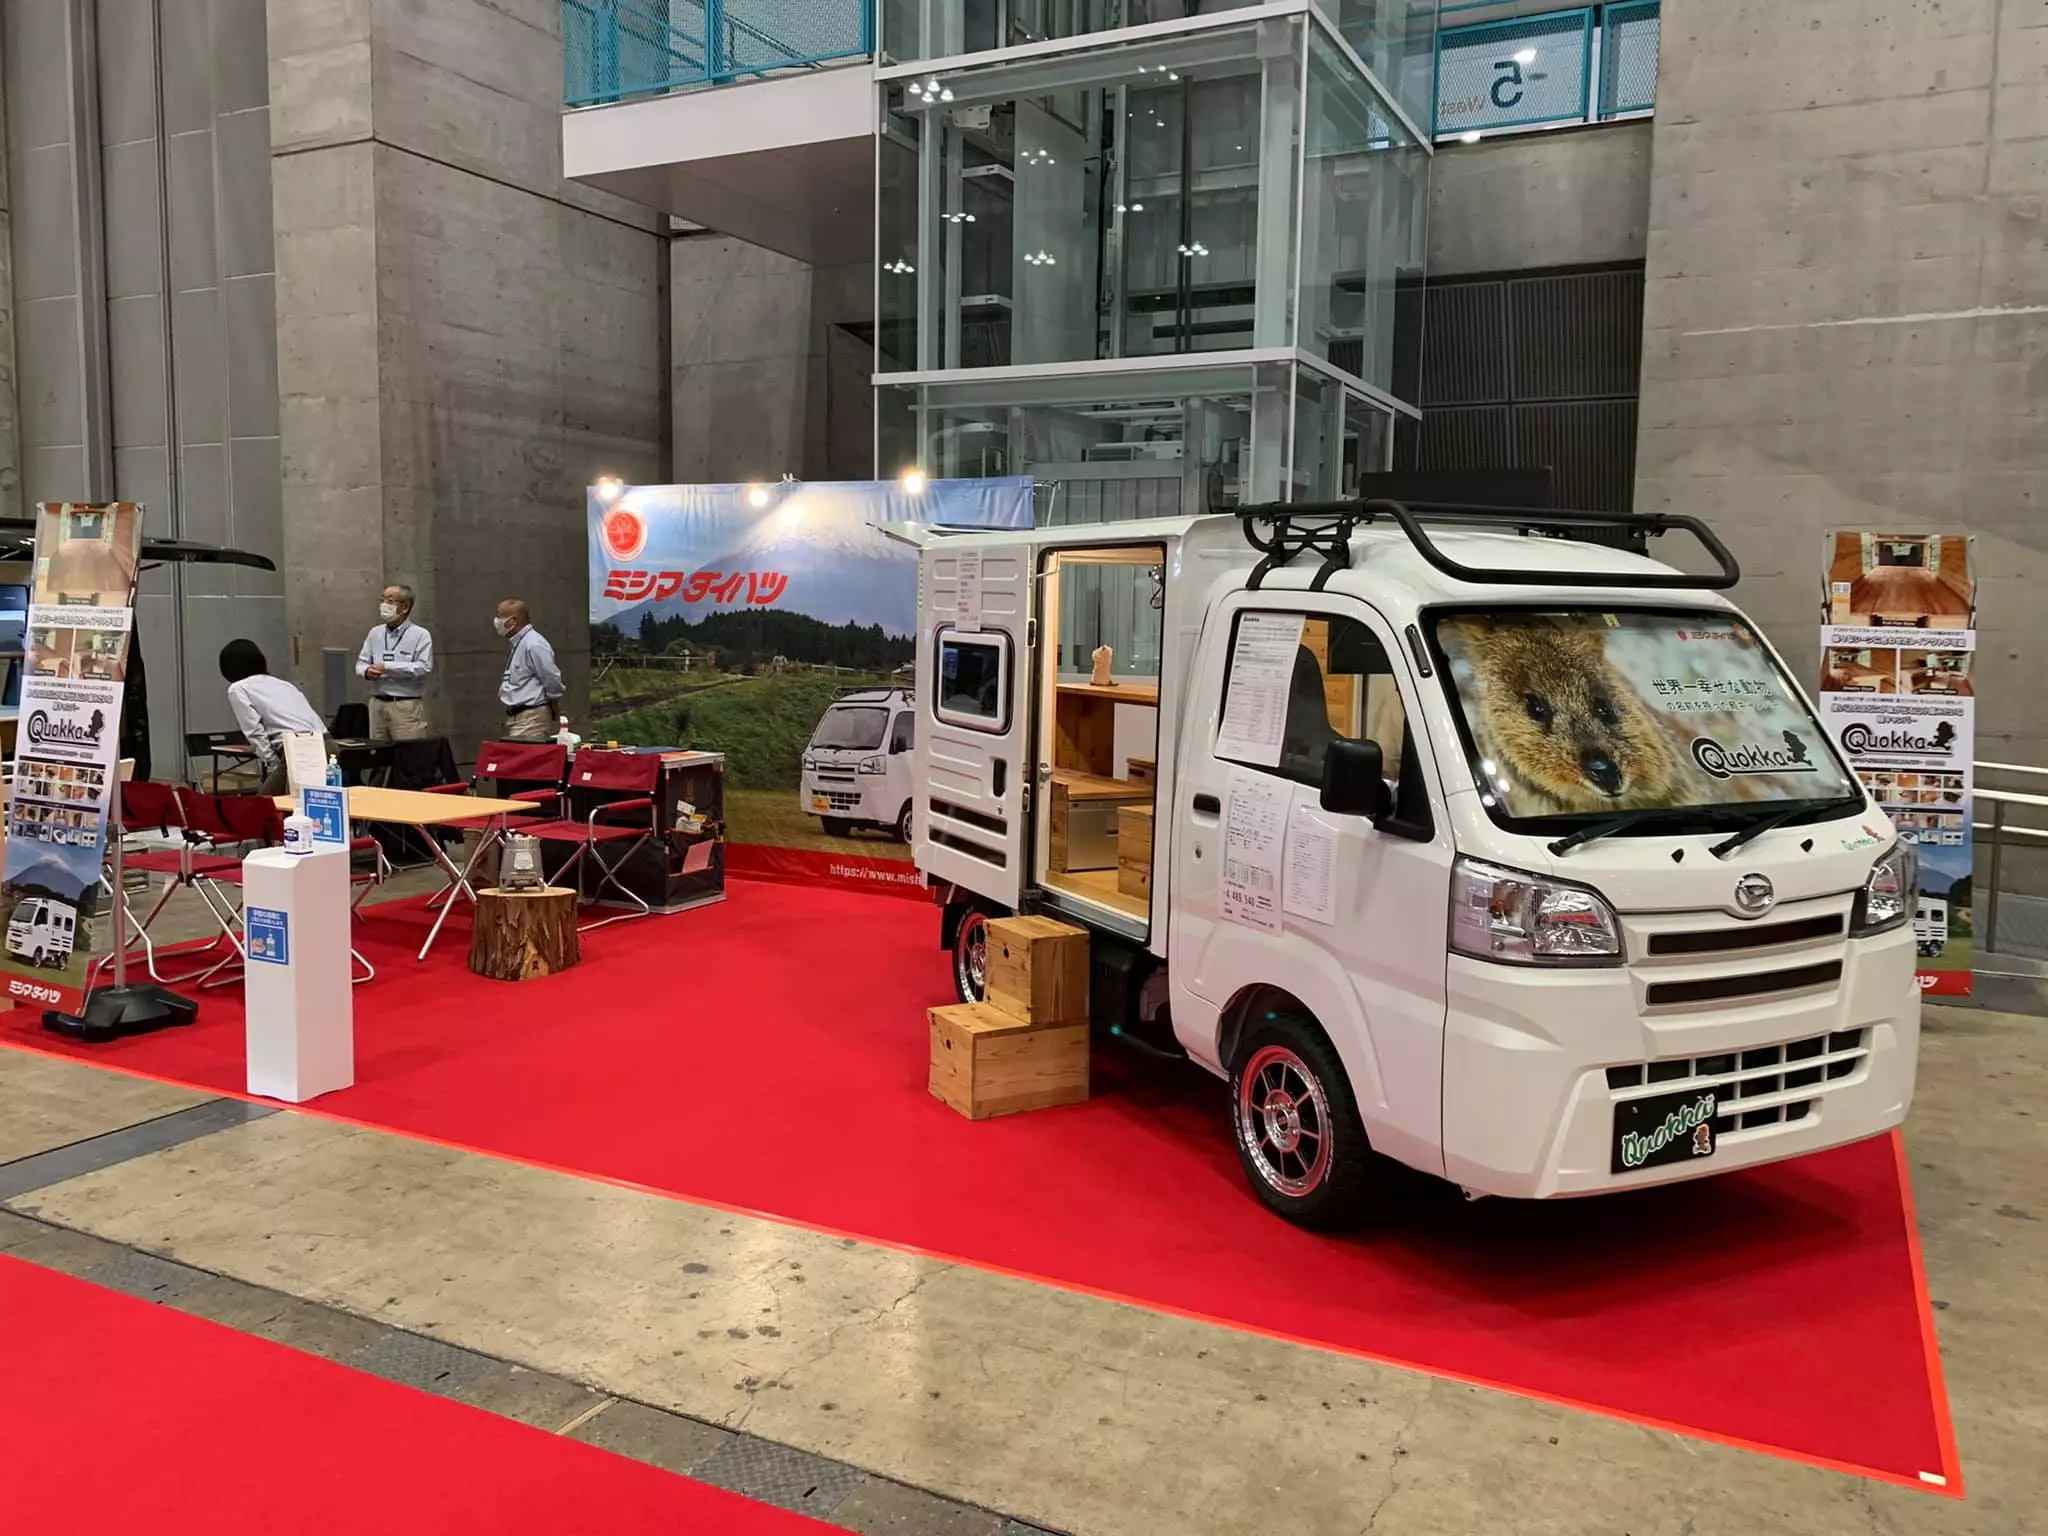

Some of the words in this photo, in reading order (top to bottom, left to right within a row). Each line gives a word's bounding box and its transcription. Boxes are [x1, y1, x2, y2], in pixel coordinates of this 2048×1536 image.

[603, 570, 789, 605] ミシマダイハツ
[1651, 678, 1773, 696] 世界一幸せな動物
[28, 709, 83, 743] Quokka
[1841, 723, 1926, 755] Quokka
[1691, 737, 1788, 780] Quokka
